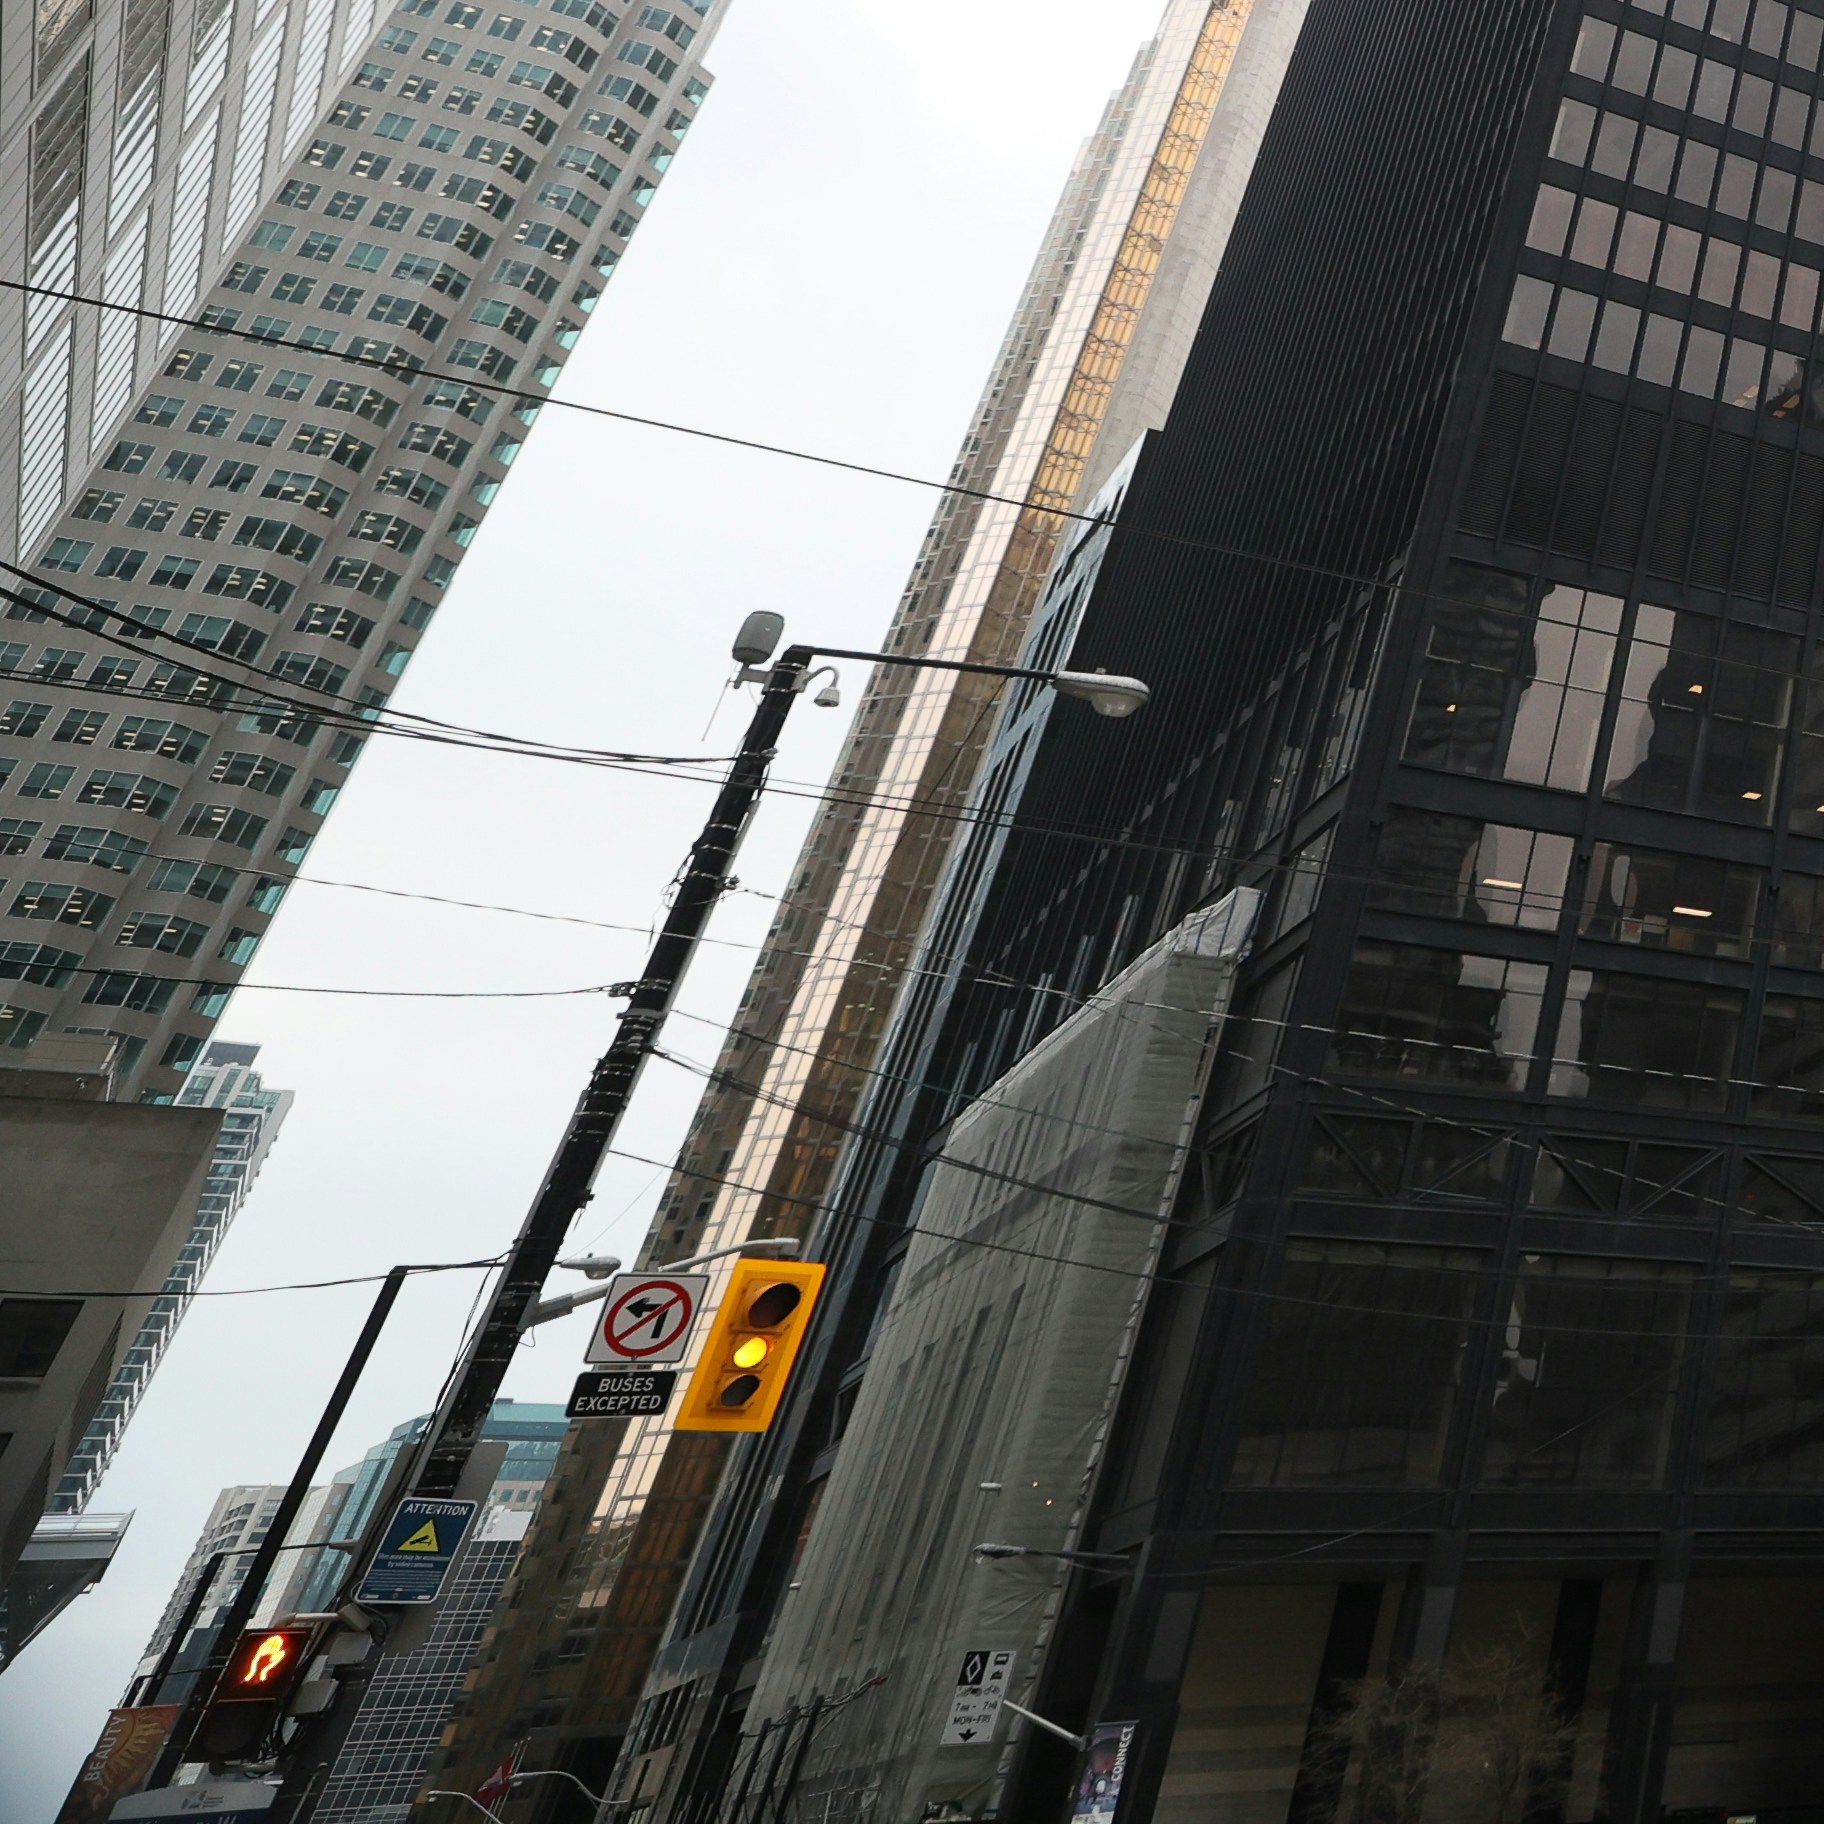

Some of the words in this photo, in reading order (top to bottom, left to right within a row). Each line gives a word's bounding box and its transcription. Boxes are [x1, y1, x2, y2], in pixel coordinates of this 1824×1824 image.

[598, 1377, 655, 1393] BUSES
[575, 1395, 662, 1412] EXCEPTED
[404, 1503, 470, 1516] ATTENTION
[83, 1715, 128, 1783] BEAUTY
[1110, 1724, 1135, 1782] CONNECT
